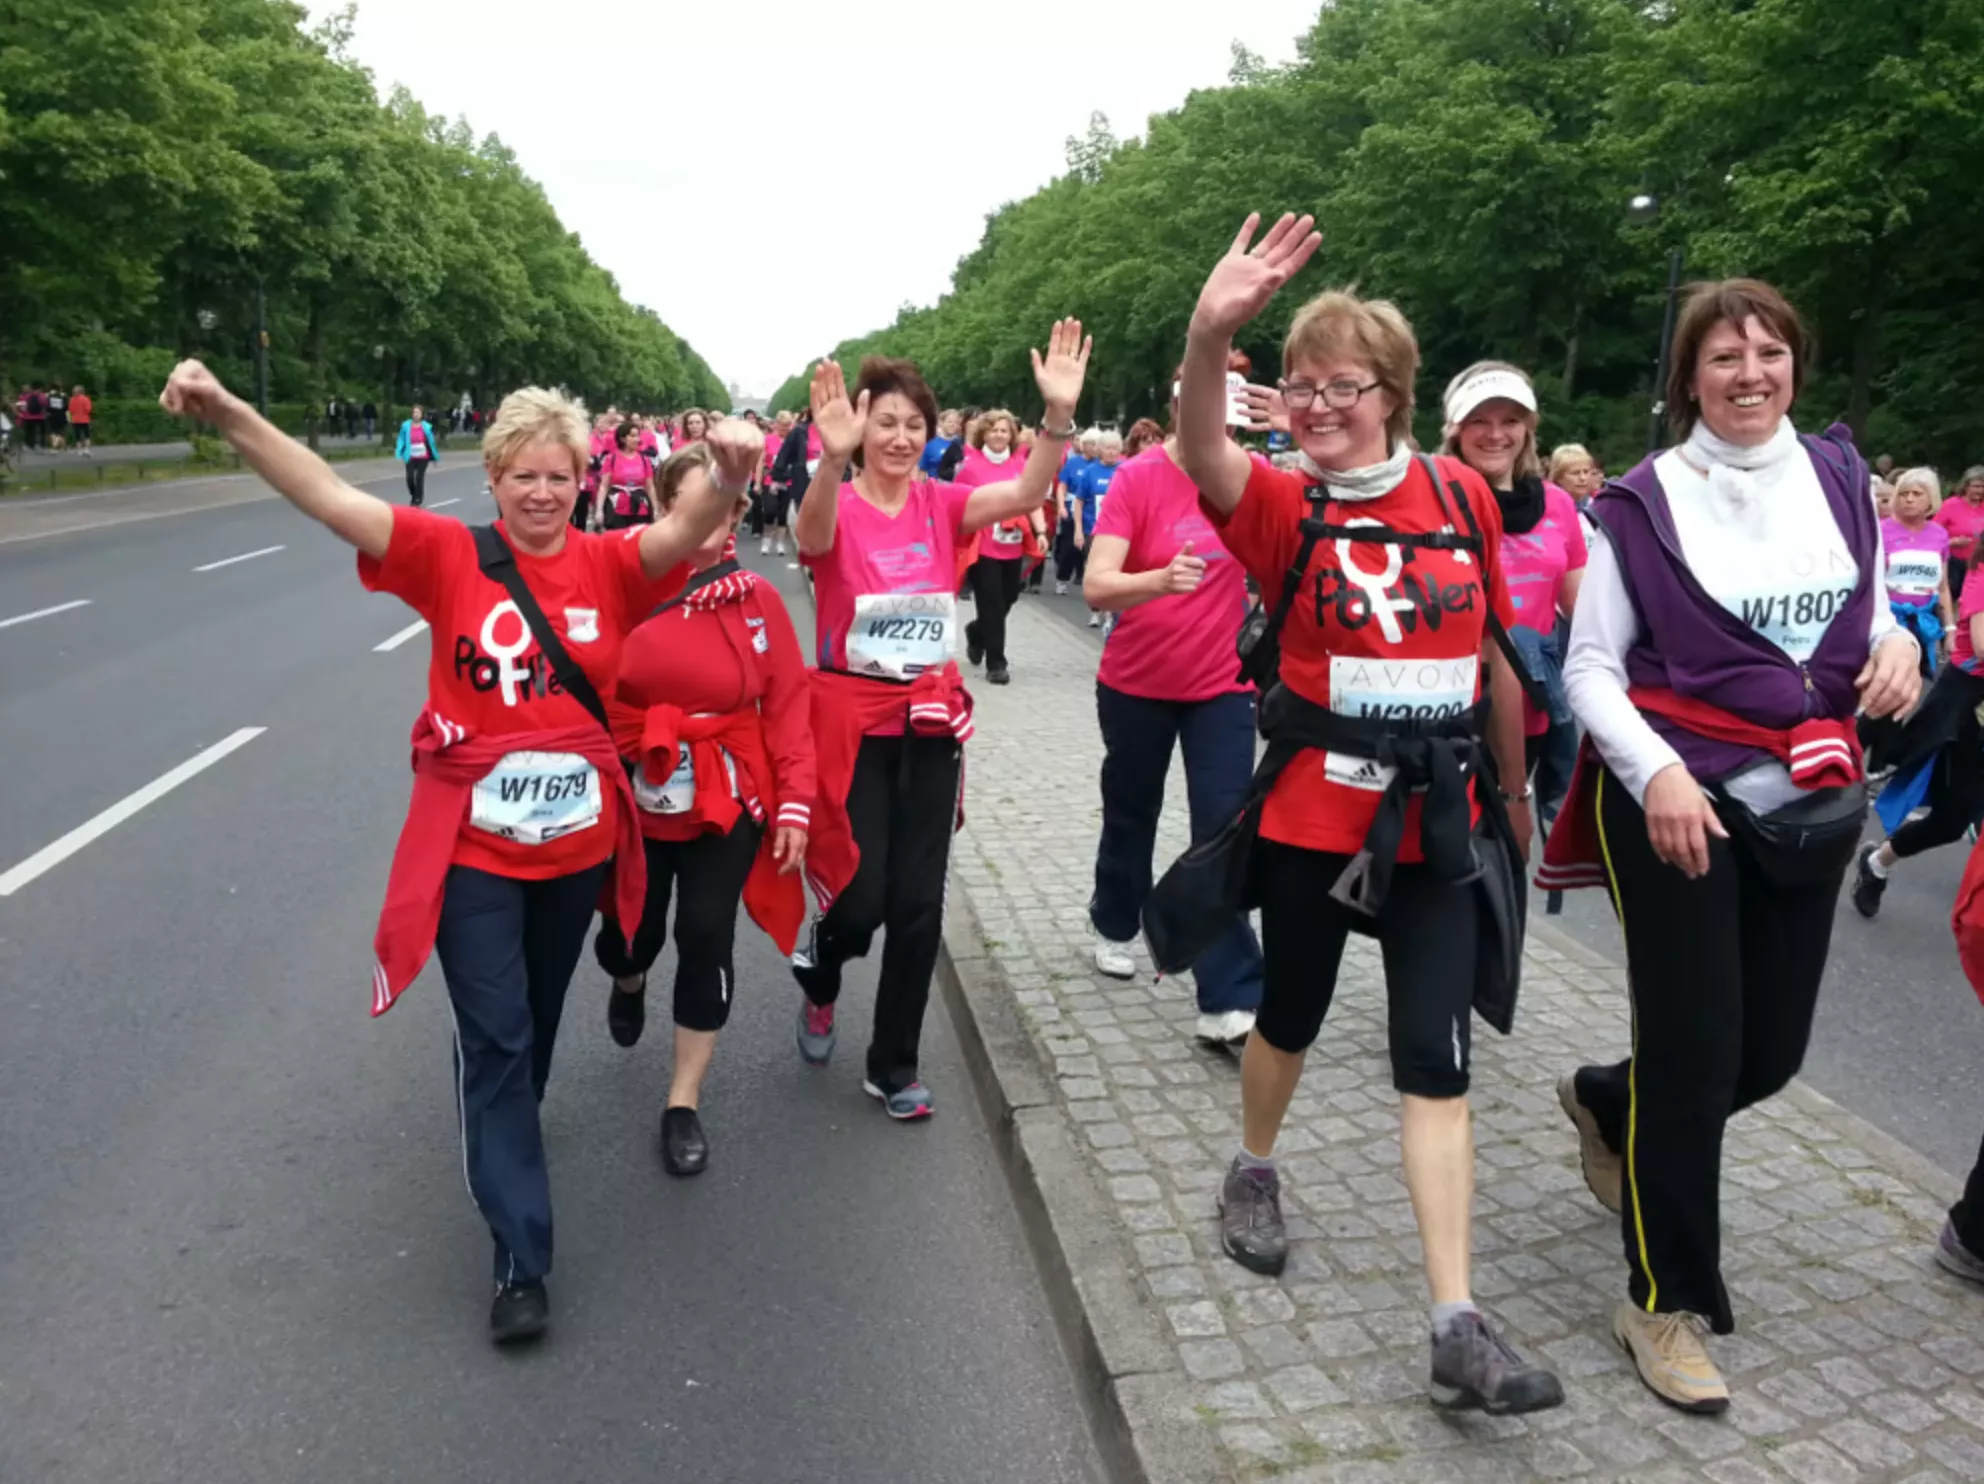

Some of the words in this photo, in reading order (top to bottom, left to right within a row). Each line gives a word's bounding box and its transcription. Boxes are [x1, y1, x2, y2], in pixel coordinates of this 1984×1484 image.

[868, 597, 949, 613] AVON
[868, 619, 944, 641] W2279
[1350, 664, 1468, 690] AVON
[501, 772, 588, 802] W1679
